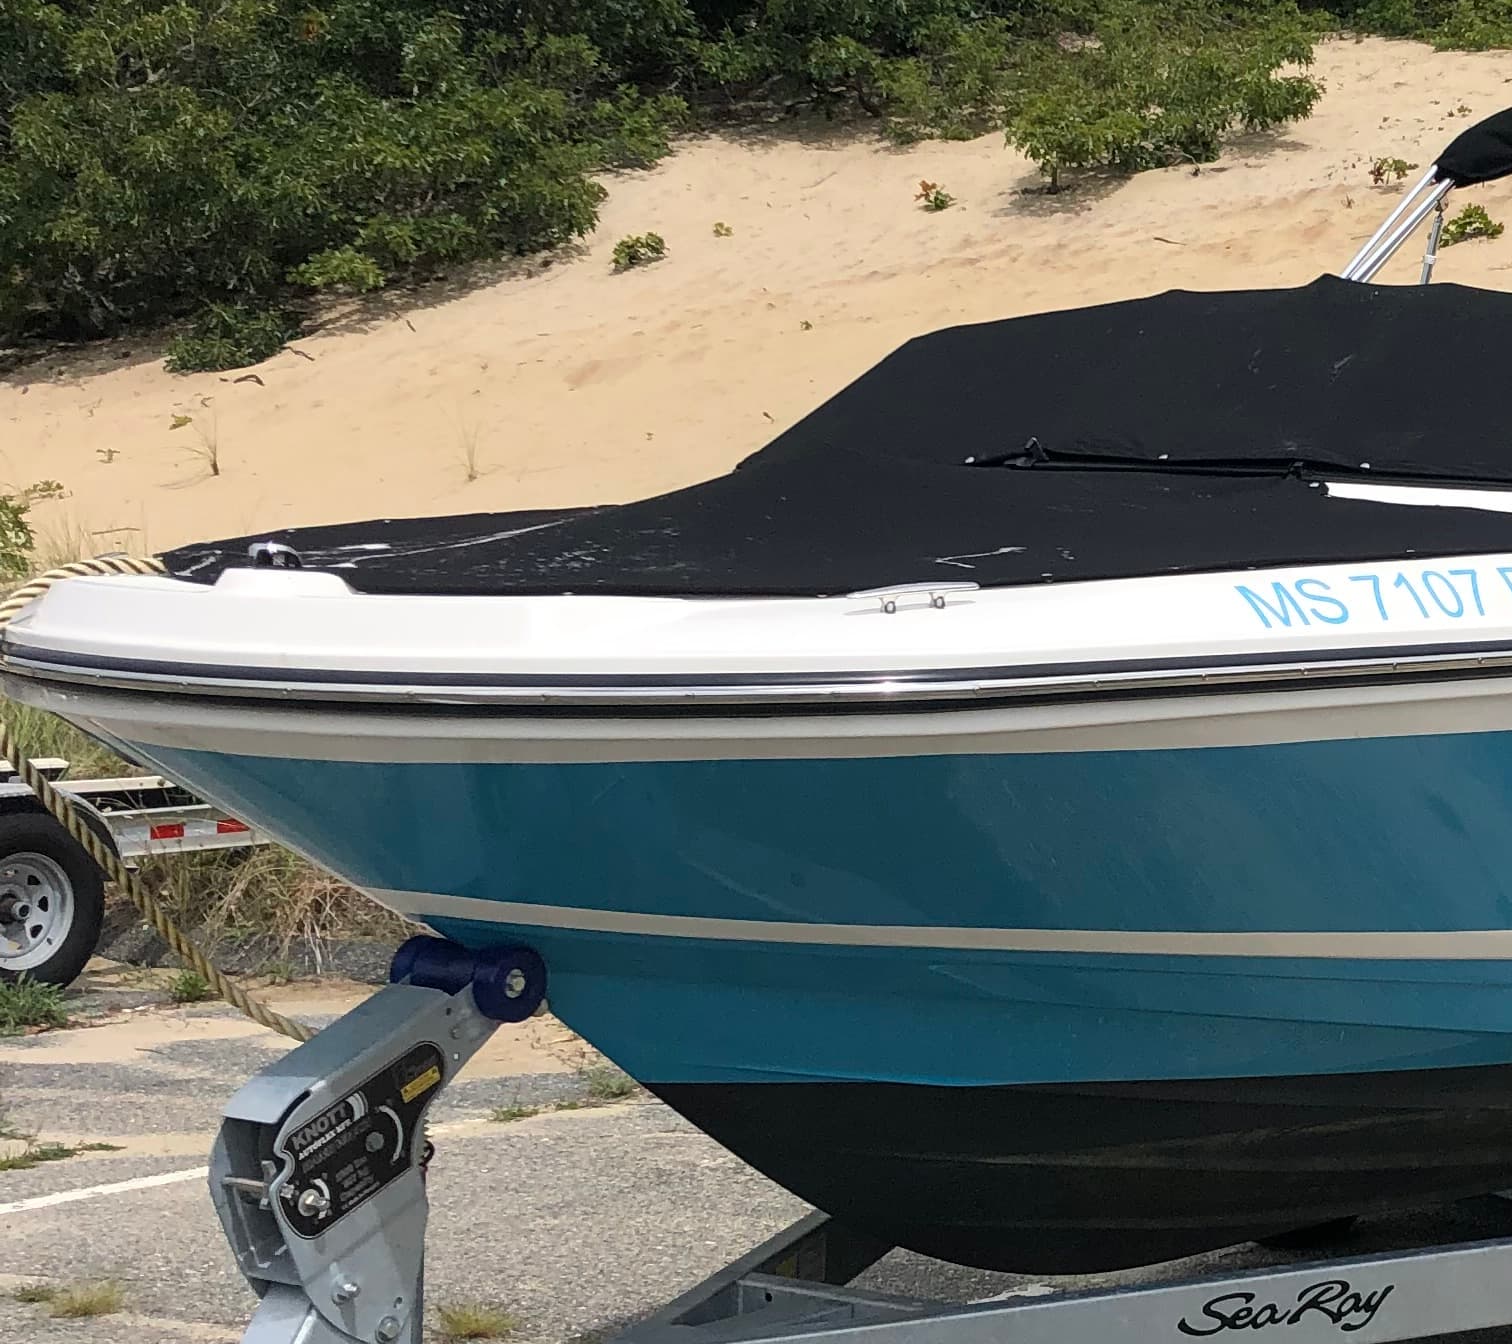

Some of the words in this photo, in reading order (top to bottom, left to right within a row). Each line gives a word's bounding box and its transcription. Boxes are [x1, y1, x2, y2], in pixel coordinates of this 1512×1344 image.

[1234, 578, 1349, 628] MS
[1348, 565, 1485, 621] 7107
[291, 1101, 350, 1151] KNOTT
